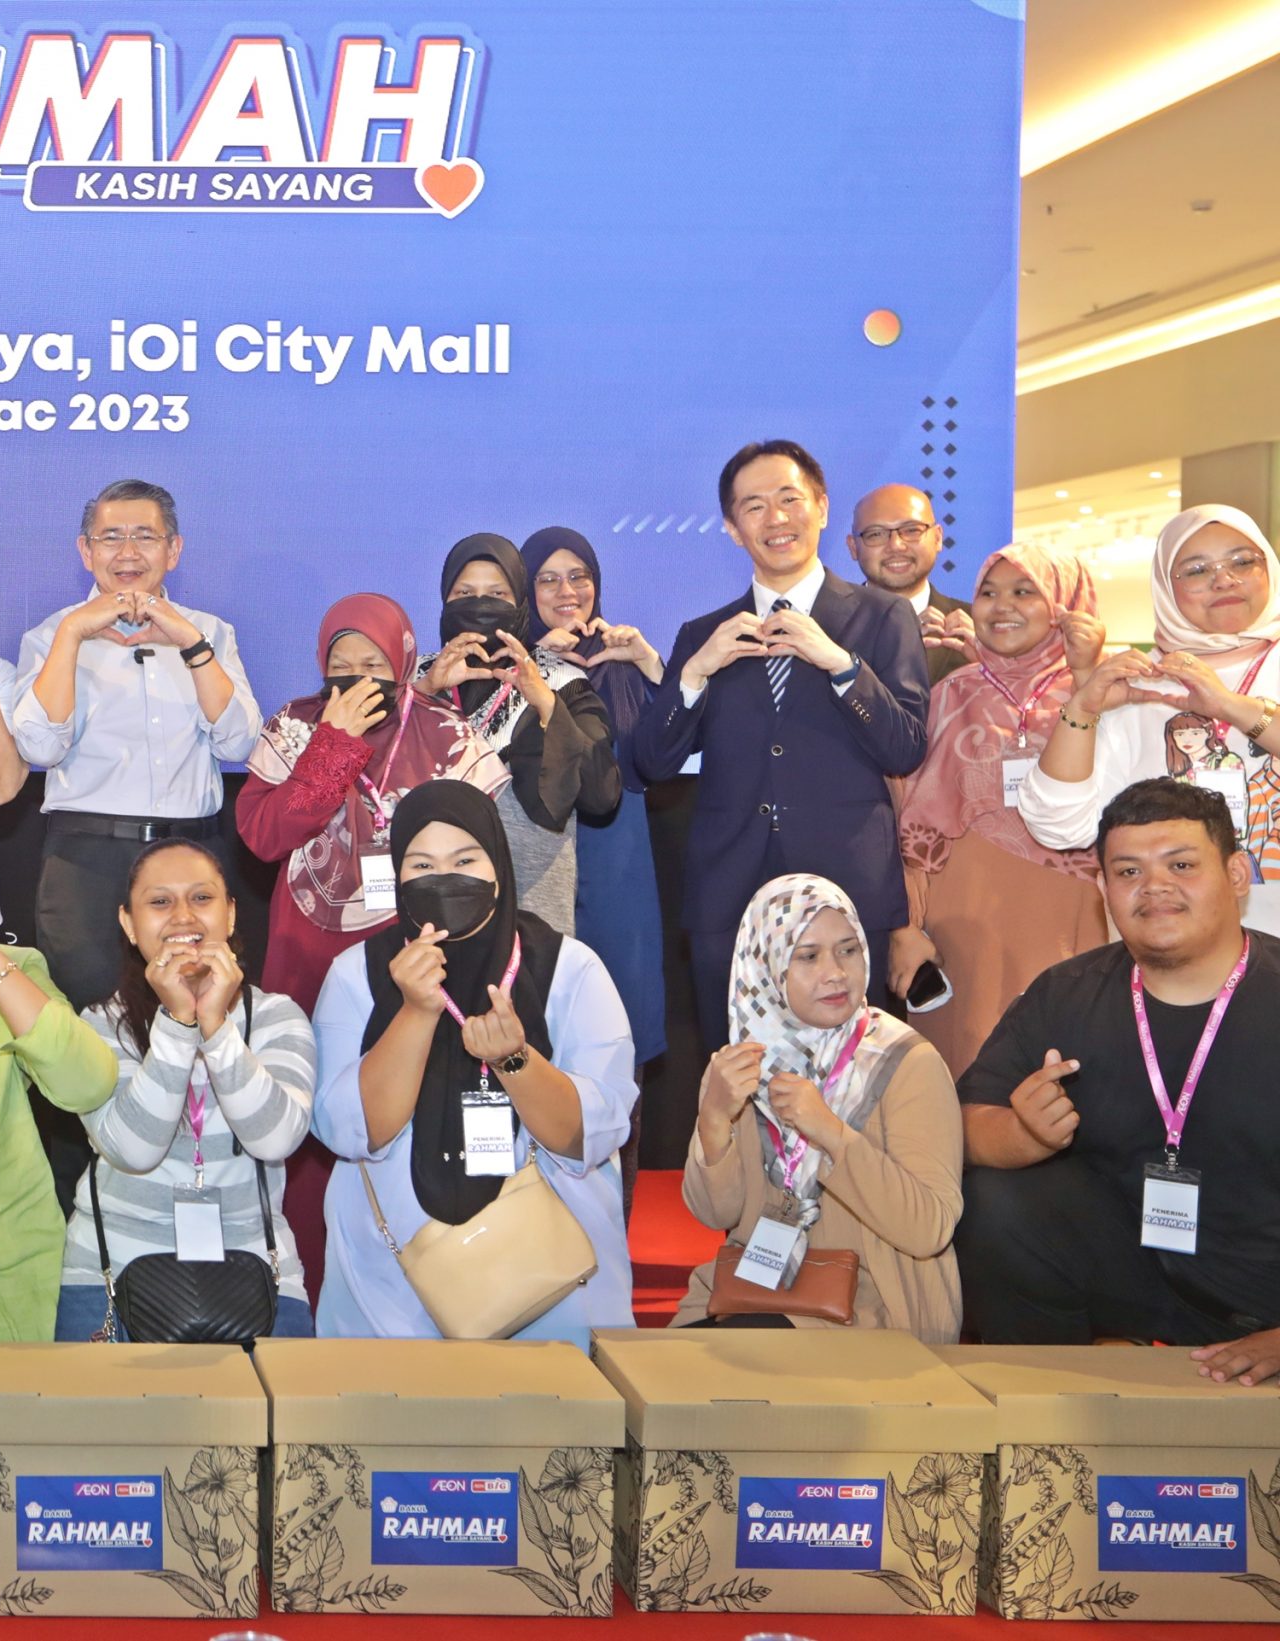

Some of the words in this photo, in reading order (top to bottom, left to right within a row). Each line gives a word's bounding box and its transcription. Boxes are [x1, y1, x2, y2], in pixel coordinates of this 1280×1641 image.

[75, 172, 198, 200] KASIH
[209, 173, 373, 201] SAYANG
[110, 319, 197, 372] iOi
[215, 320, 353, 385] City
[365, 324, 510, 373] Mall
[69, 393, 189, 432] 2023
[1144, 1214, 1196, 1231] RAHMAH
[1151, 1207, 1189, 1218] PENERIMA
[487, 1480, 506, 1490] BIG
[854, 1486, 873, 1496] BIG
[1215, 1485, 1234, 1495] BIG
[1126, 1510, 1155, 1518] BAKUL
[28, 1522, 151, 1544] RAHMAH
[383, 1518, 506, 1538] RAHMAH
[748, 1522, 872, 1543] RAHMAH
[1110, 1523, 1234, 1544] RAHMAH
